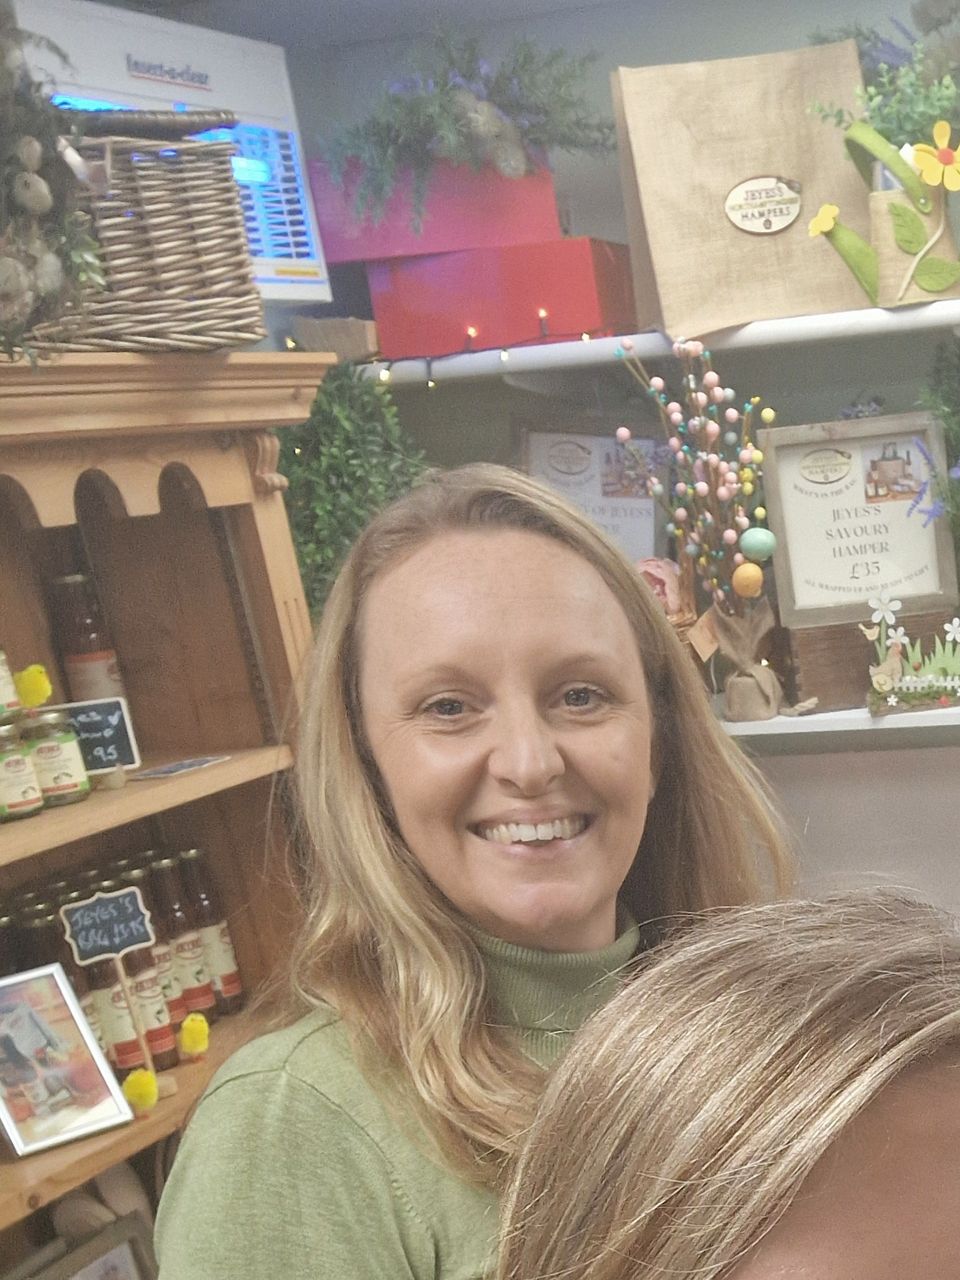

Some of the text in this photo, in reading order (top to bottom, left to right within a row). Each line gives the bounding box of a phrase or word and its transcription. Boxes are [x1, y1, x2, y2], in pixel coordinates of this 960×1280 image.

[741, 206, 791, 221] HAMPERS
[832, 504, 883, 523] JEYES'S
[824, 523, 890, 541] SAVOURY
[832, 541, 891, 559] HAMPER
[849, 560, 882, 581] £35
